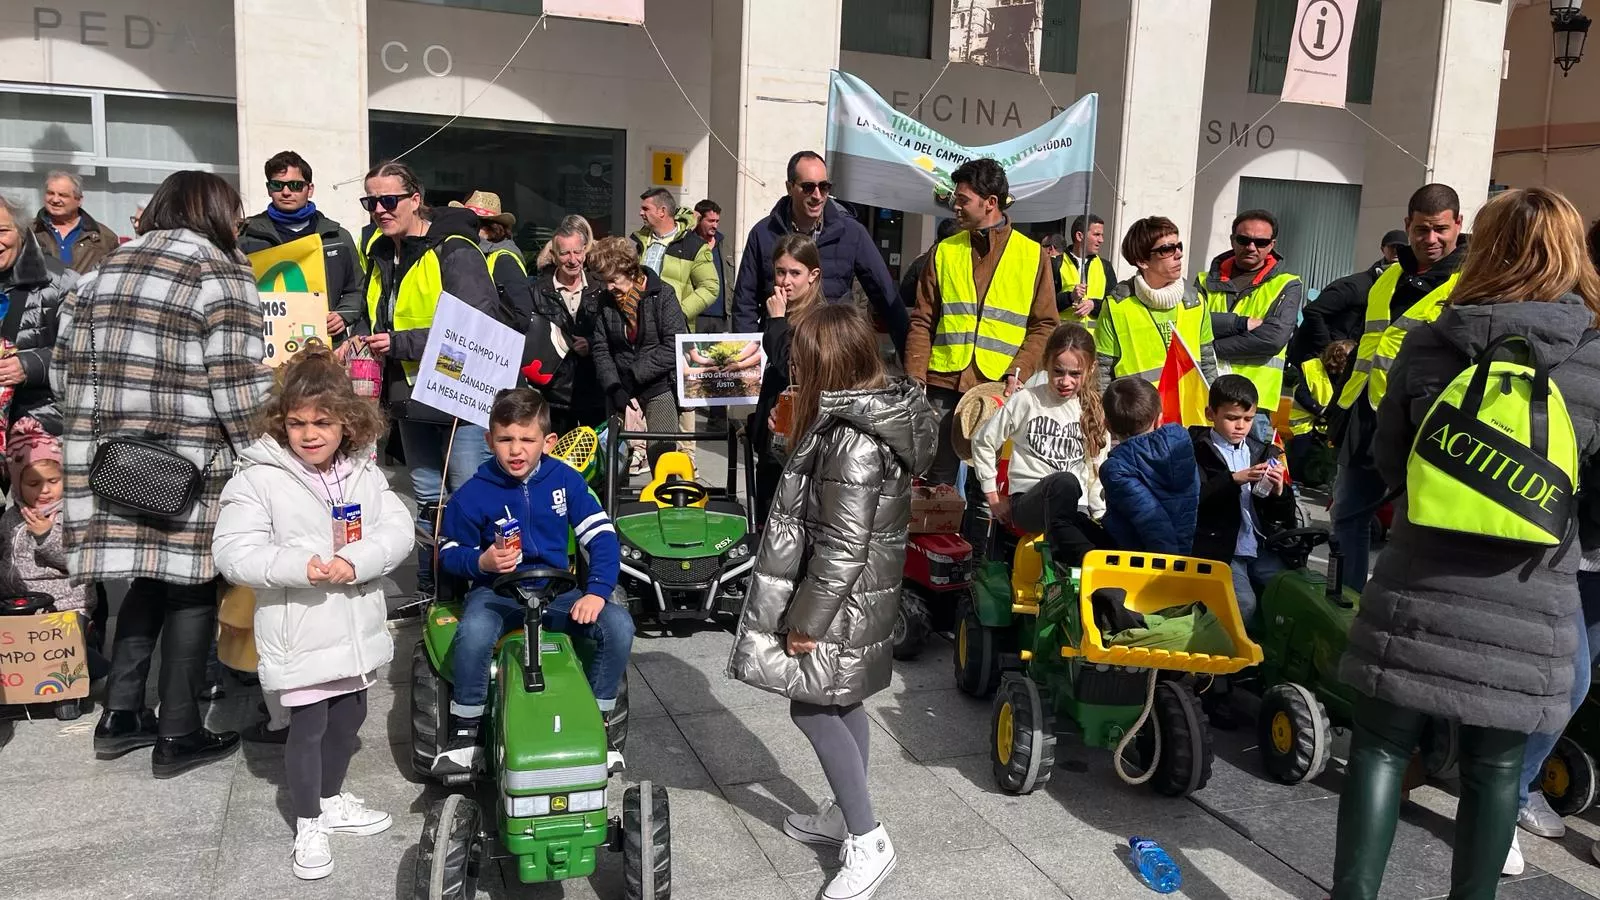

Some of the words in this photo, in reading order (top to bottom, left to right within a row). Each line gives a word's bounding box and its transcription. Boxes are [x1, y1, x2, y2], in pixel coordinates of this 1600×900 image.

[892, 90, 1022, 129] FICINA
[856, 116, 870, 127] LA
[914, 141, 932, 156] DEL
[444, 328, 459, 343] SIN
[458, 336, 467, 348] EL
[468, 341, 494, 361] CAMPO
[495, 353, 501, 364] Y
[500, 355, 509, 368] LA
[426, 379, 438, 393] LA
[438, 384, 458, 400] MESA
[459, 394, 477, 410] ESTA
[478, 402, 492, 415] VAC
[460, 373, 499, 397] GANADERI
[1026, 415, 1061, 437] TRUE
[1026, 434, 1047, 456] ARE
[1048, 437, 1084, 460] ALWA
[1426, 423, 1564, 515] ACTITUDE
[715, 537, 732, 550] RSX
[28, 628, 63, 644] POR
[43, 646, 75, 661] CON
